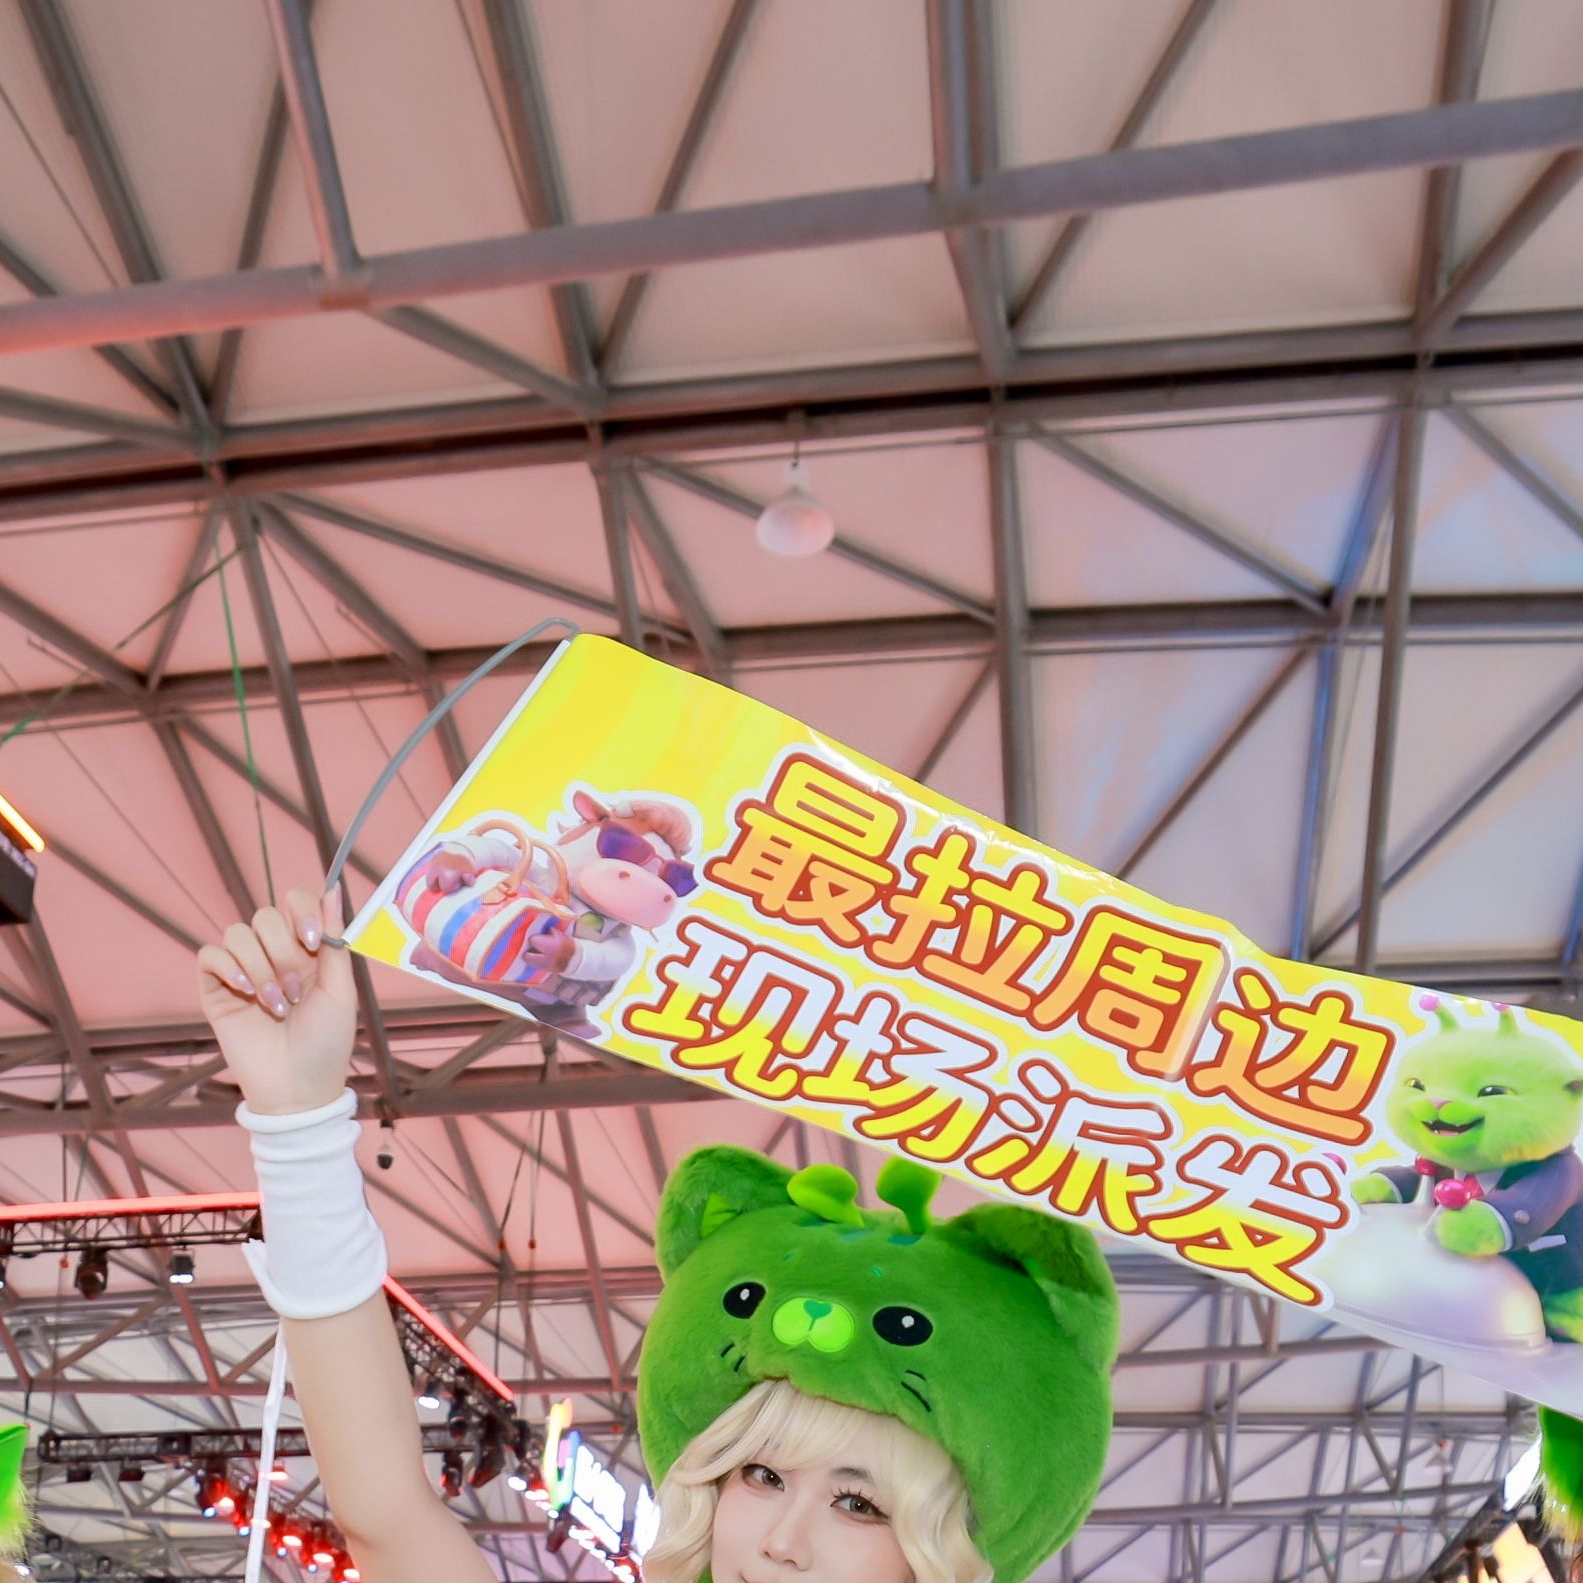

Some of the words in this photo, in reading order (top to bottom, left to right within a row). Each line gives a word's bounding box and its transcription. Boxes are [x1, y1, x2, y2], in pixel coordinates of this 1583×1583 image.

[624, 919, 1354, 1312] 现场派发
[703, 746, 1401, 1147] 最拉周边
